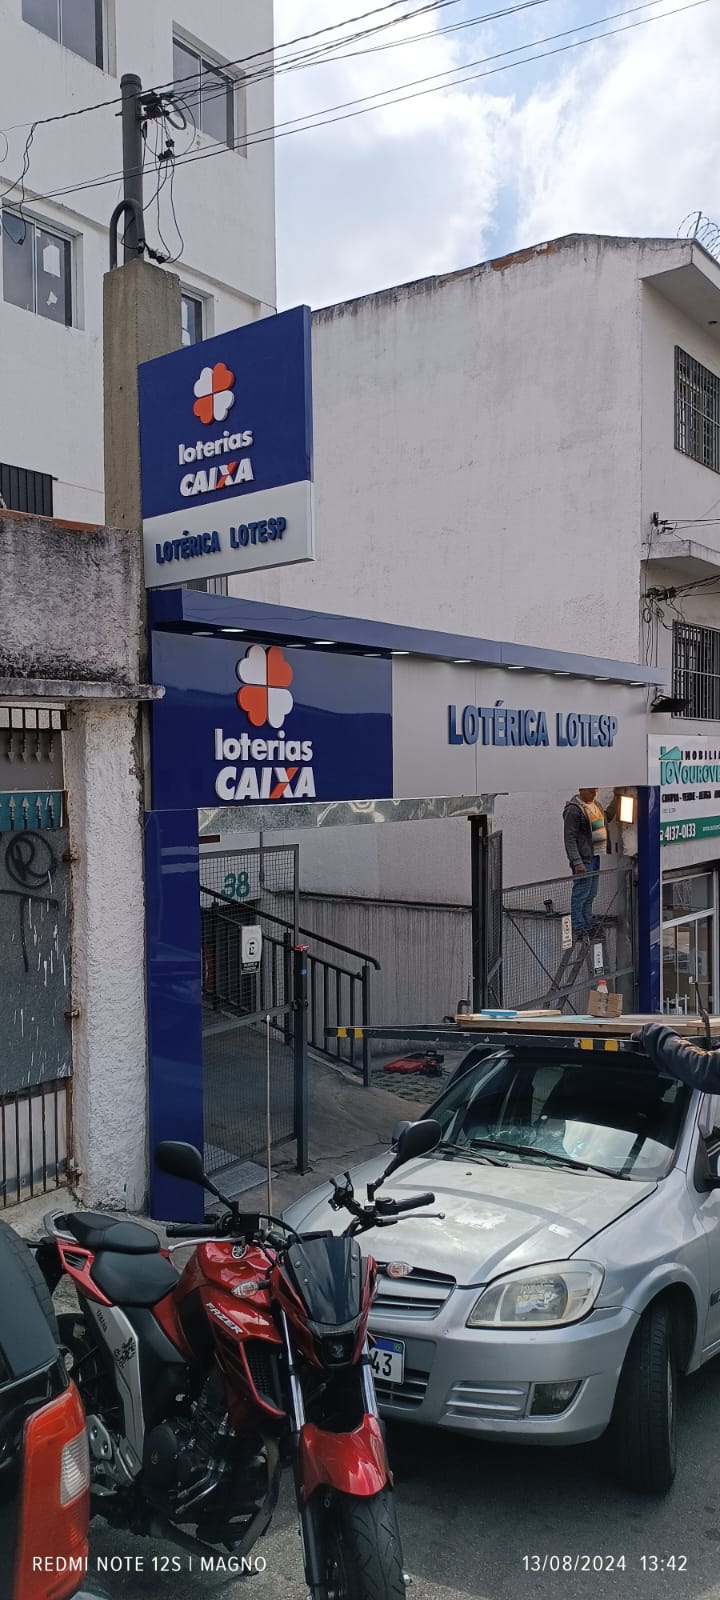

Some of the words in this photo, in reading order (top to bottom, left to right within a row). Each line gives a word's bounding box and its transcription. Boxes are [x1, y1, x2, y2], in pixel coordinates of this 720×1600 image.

[178, 430, 254, 465] loterias
[179, 458, 255, 497] CAIXA
[155, 530, 221, 564] LOTÉRICA
[229, 516, 287, 549] LOTESP
[448, 700, 549, 747] LOTÉRICA
[556, 712, 618, 748] LOTESP
[214, 728, 313, 762] loterias
[215, 766, 317, 801] CAIXA
[221, 871, 250, 898] 38
[205, 1302, 244, 1335] FAZER
